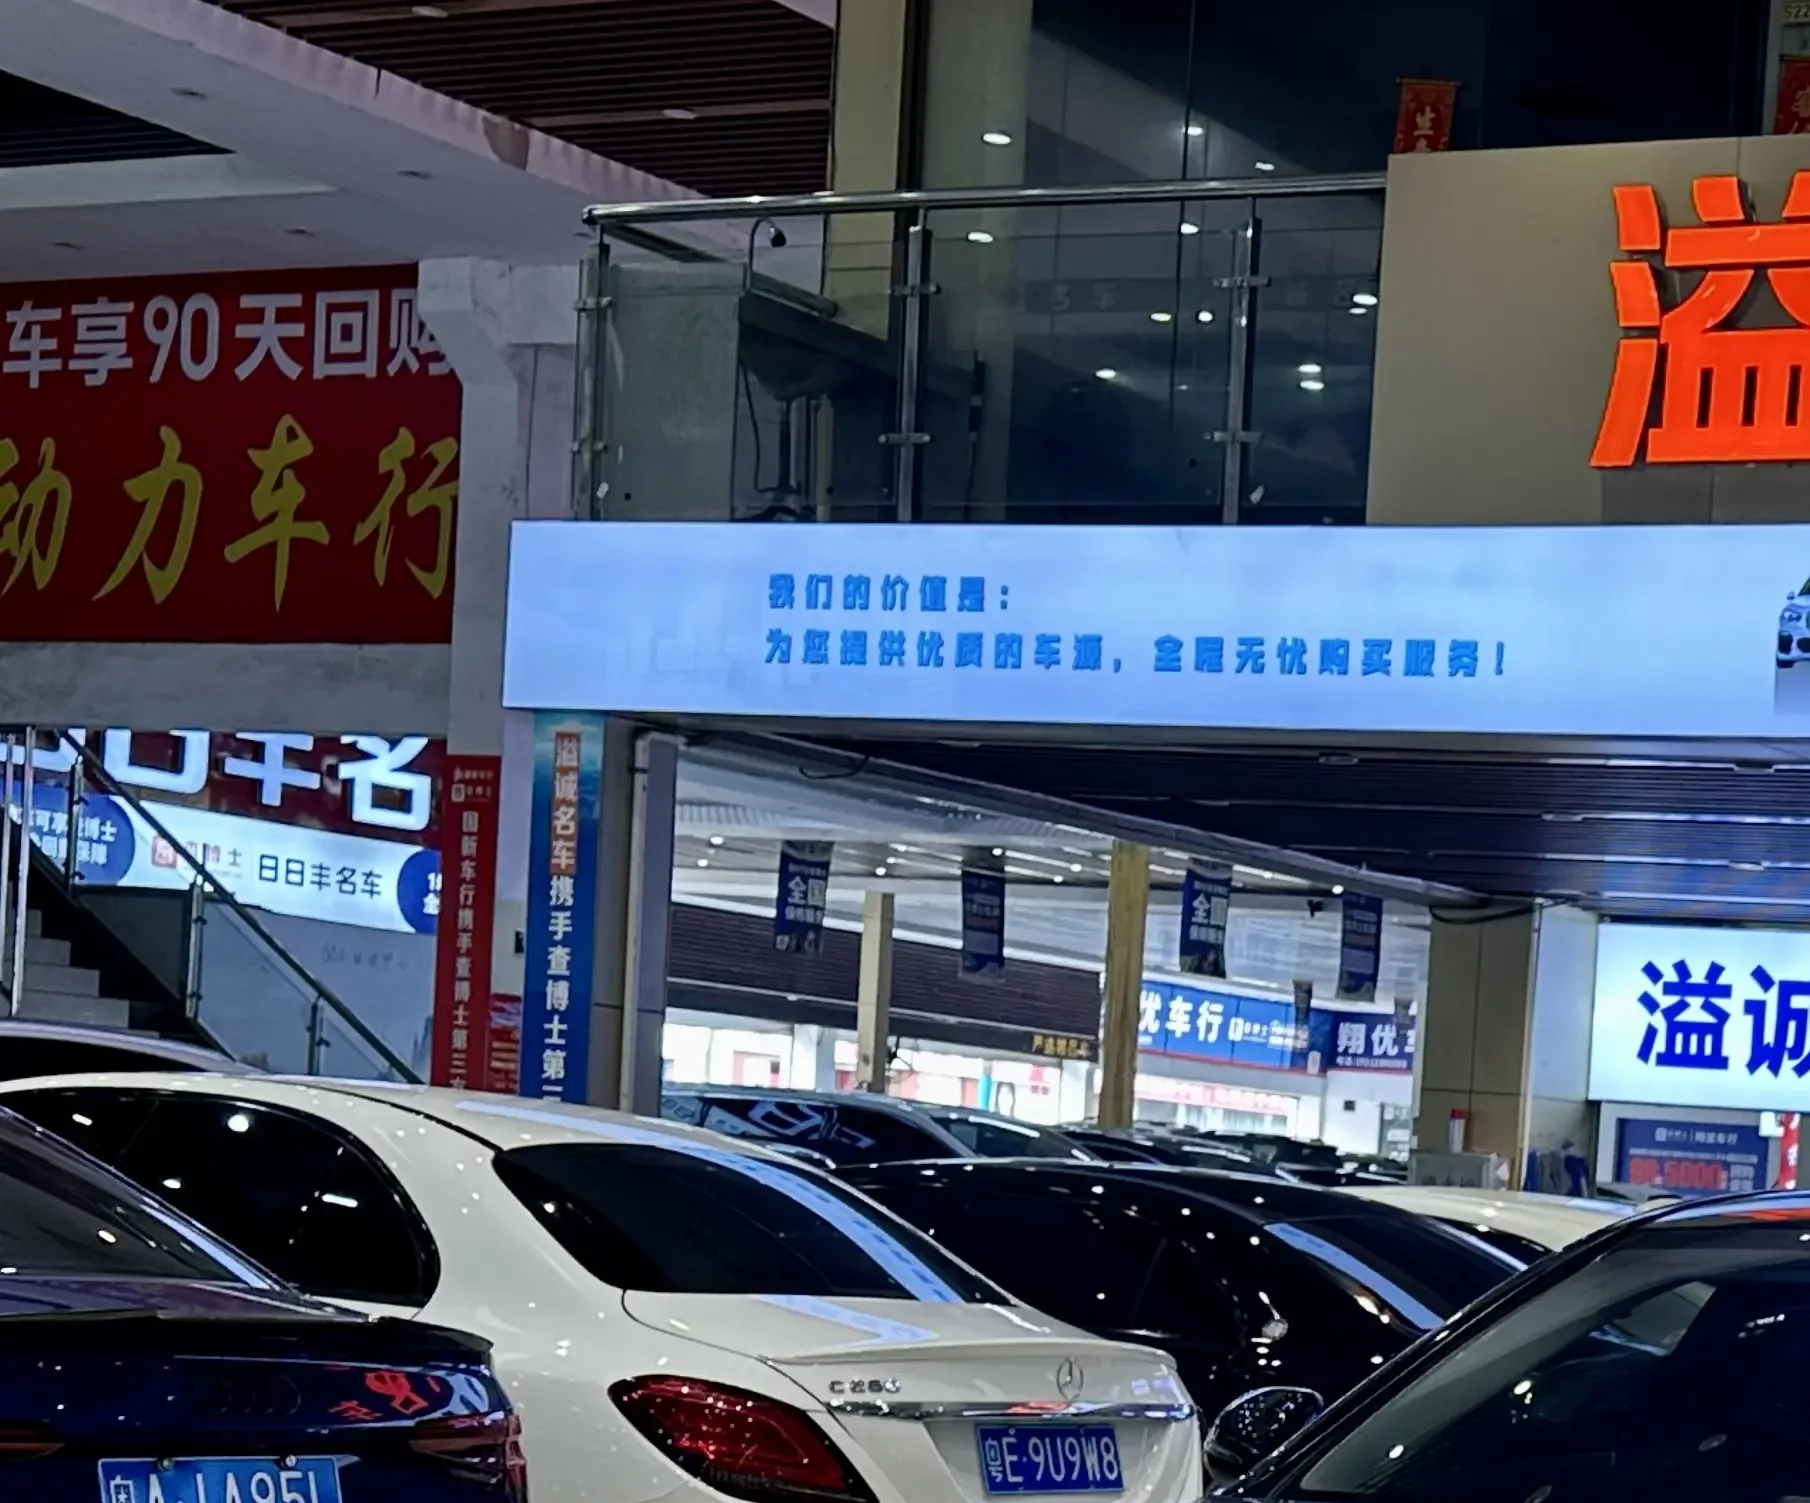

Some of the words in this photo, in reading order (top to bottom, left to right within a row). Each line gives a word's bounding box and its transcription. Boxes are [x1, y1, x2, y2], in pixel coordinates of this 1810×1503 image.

[259, 853, 384, 899] 日日丰名车
